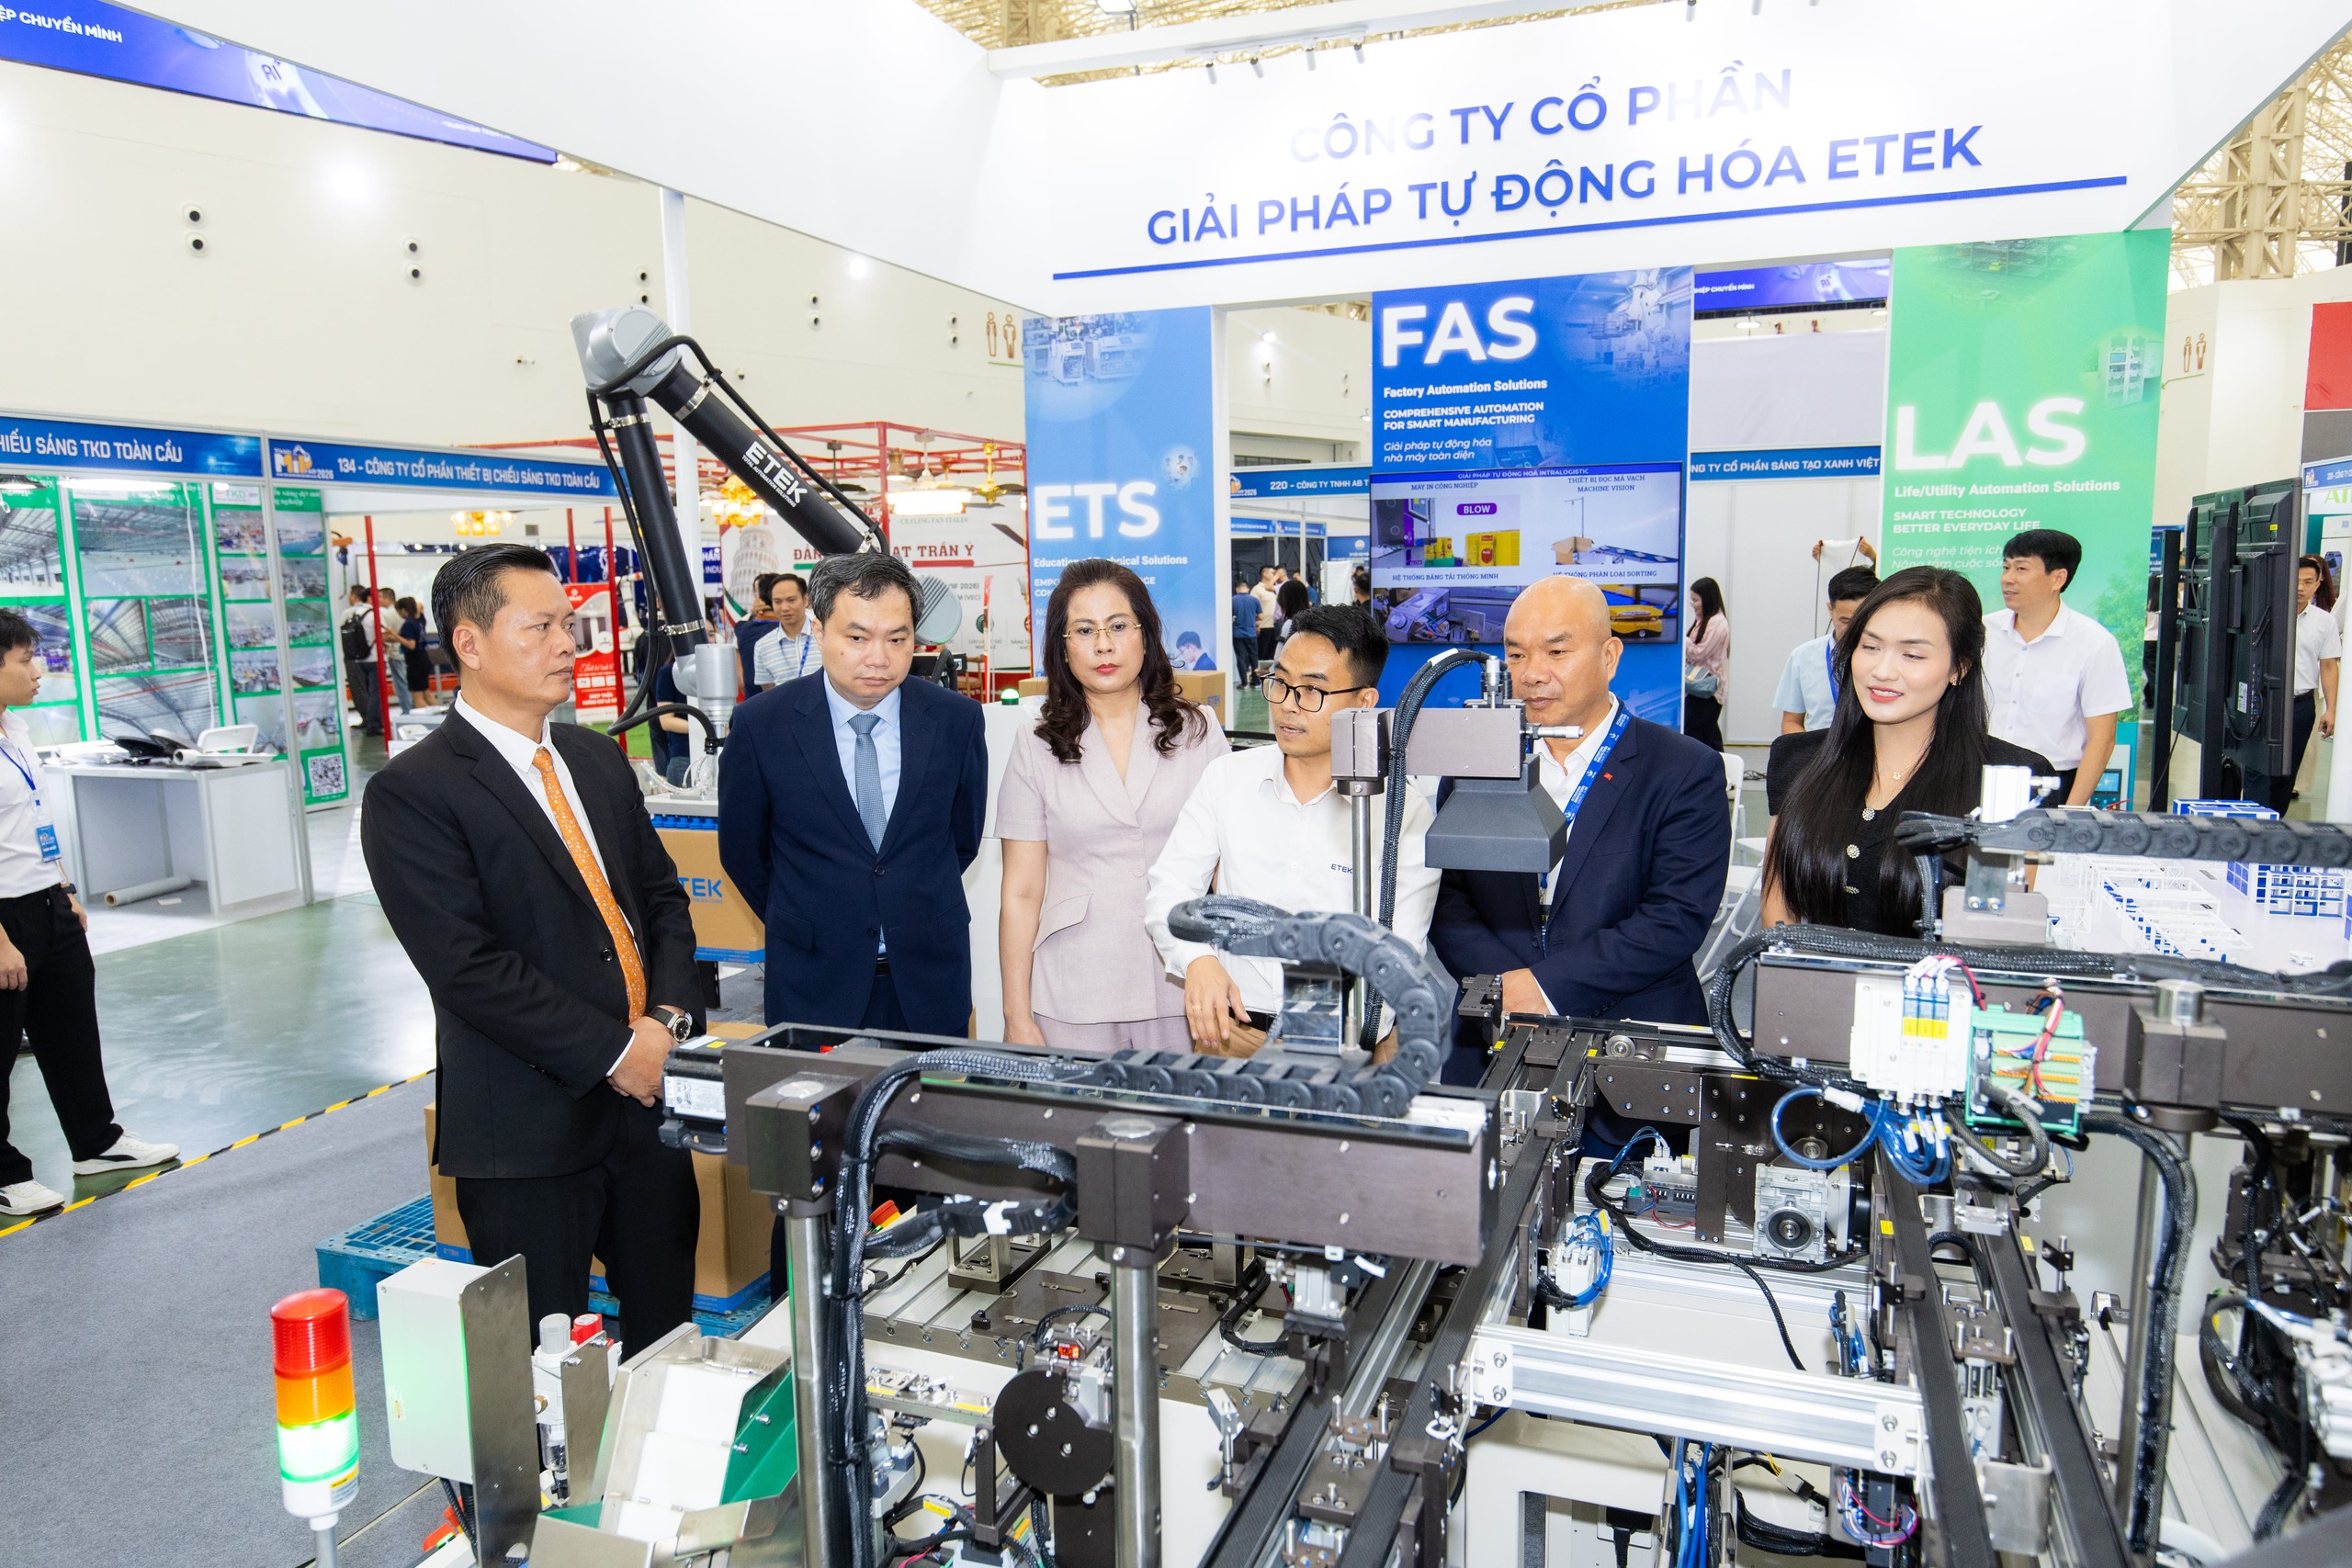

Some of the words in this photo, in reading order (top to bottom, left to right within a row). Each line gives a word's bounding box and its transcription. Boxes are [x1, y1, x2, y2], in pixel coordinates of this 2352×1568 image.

[19, 11, 83, 35] CHUYỂN
[85, 24, 123, 43] MÌNH
[1290, 112, 1436, 164] CÔNG
[1450, 100, 1515, 145] TY
[1530, 76, 1608, 135] CỔ
[1628, 59, 1792, 126] PHẦN
[1147, 191, 1239, 245] GIẢI
[1257, 181, 1393, 235] PHÁP
[1408, 170, 1477, 227] TỰ
[1490, 158, 1656, 219] ĐỘNG
[1677, 139, 1806, 195] HÓA
[1827, 124, 1984, 181] ETEK
[1383, 297, 1537, 367] FAS
[1384, 384, 1425, 399] Factory
[1427, 381, 1491, 396] Automation
[1493, 378, 1548, 391] Solutions
[1384, 405, 1471, 419] COMPREHENSIVE
[1473, 401, 1544, 414] AUTOMATION
[1384, 421, 1405, 431] FOR
[1407, 418, 1442, 429] SMART
[1444, 413, 1535, 427] MANUFACTURING
[1894, 397, 2086, 470] LAS
[36, 433, 78, 457] SÁNG
[80, 439, 111, 459] TKD
[113, 438, 153, 461] TOÀN
[154, 439, 183, 463] CẦU
[1384, 441, 1403, 452] Giải
[1404, 440, 1430, 452] pháp
[1432, 439, 1444, 450] tự
[1445, 437, 1471, 449] động
[1472, 436, 1492, 447] hóa
[1384, 452, 1403, 462] nhà
[1405, 451, 1428, 463] máy
[1429, 450, 1452, 461] toàn
[1453, 448, 1475, 461] diện
[337, 457, 356, 474] 134
[365, 456, 395, 477] CÔNG
[396, 461, 410, 477] TY
[411, 457, 425, 478] CỔ
[427, 459, 453, 479] PHẦN
[455, 462, 481, 481] THIẾT
[482, 468, 492, 485] BỊ
[492, 465, 520, 484] CHIẾU
[520, 468, 544, 486] SÁNG
[544, 471, 560, 487] TKD
[562, 471, 584, 489] TOÀN
[583, 470, 600, 490] CẦU
[745, 441, 808, 503] ETEK
[1690, 463, 1706, 473] NG
[1708, 462, 1721, 472] TY
[1723, 459, 1738, 472] CỔ
[1740, 459, 1769, 471] PHẦN
[1771, 458, 1800, 470] SÁNG
[1802, 459, 1822, 471] TẠO
[1824, 458, 1854, 469] XANH
[1857, 456, 1881, 469] VIỆT
[317, 468, 334, 479] 2026
[741, 454, 754, 469] TOTAL
[752, 465, 777, 491] AUTOMATION
[775, 486, 797, 508] SOLUTIONS
[1502, 469, 1522, 479] ĐỘNG
[1270, 480, 1288, 491] 220
[1296, 479, 1317, 490] CÔNG
[1318, 480, 1329, 489] TY
[1329, 479, 1351, 489] TNHH
[1351, 479, 1363, 487] AB
[1411, 482, 1425, 491] MÁY
[1434, 481, 1453, 490] CÔNG
[1453, 481, 1478, 490] NGHIỆP
[1611, 483, 1635, 491] VISION
[1894, 482, 1966, 499] Life/Utility
[1968, 481, 2050, 496] Automation
[2052, 479, 2121, 492] Solutions
[1034, 480, 1159, 539] ETS
[1463, 504, 1491, 514] BLOW
[1894, 511, 1938, 521] SMART
[1939, 508, 2028, 520] TECHNOLOGY
[1893, 523, 1940, 534] BETTER
[1943, 521, 2010, 533] EVERYDAY
[2013, 520, 2041, 531] LIFE
[918, 541, 961, 557] TRẦN
[965, 540, 975, 556] Ý
[1893, 546, 1923, 558] Công
[1926, 545, 1957, 558] nghệ
[1960, 545, 1982, 556] tiện
[1984, 544, 2004, 555] ích
[1141, 554, 1188, 566] Solutions
[1954, 558, 1984, 569] cuộc
[1392, 573, 1402, 581] HỆ
[1330, 863, 1353, 874] ETEK
